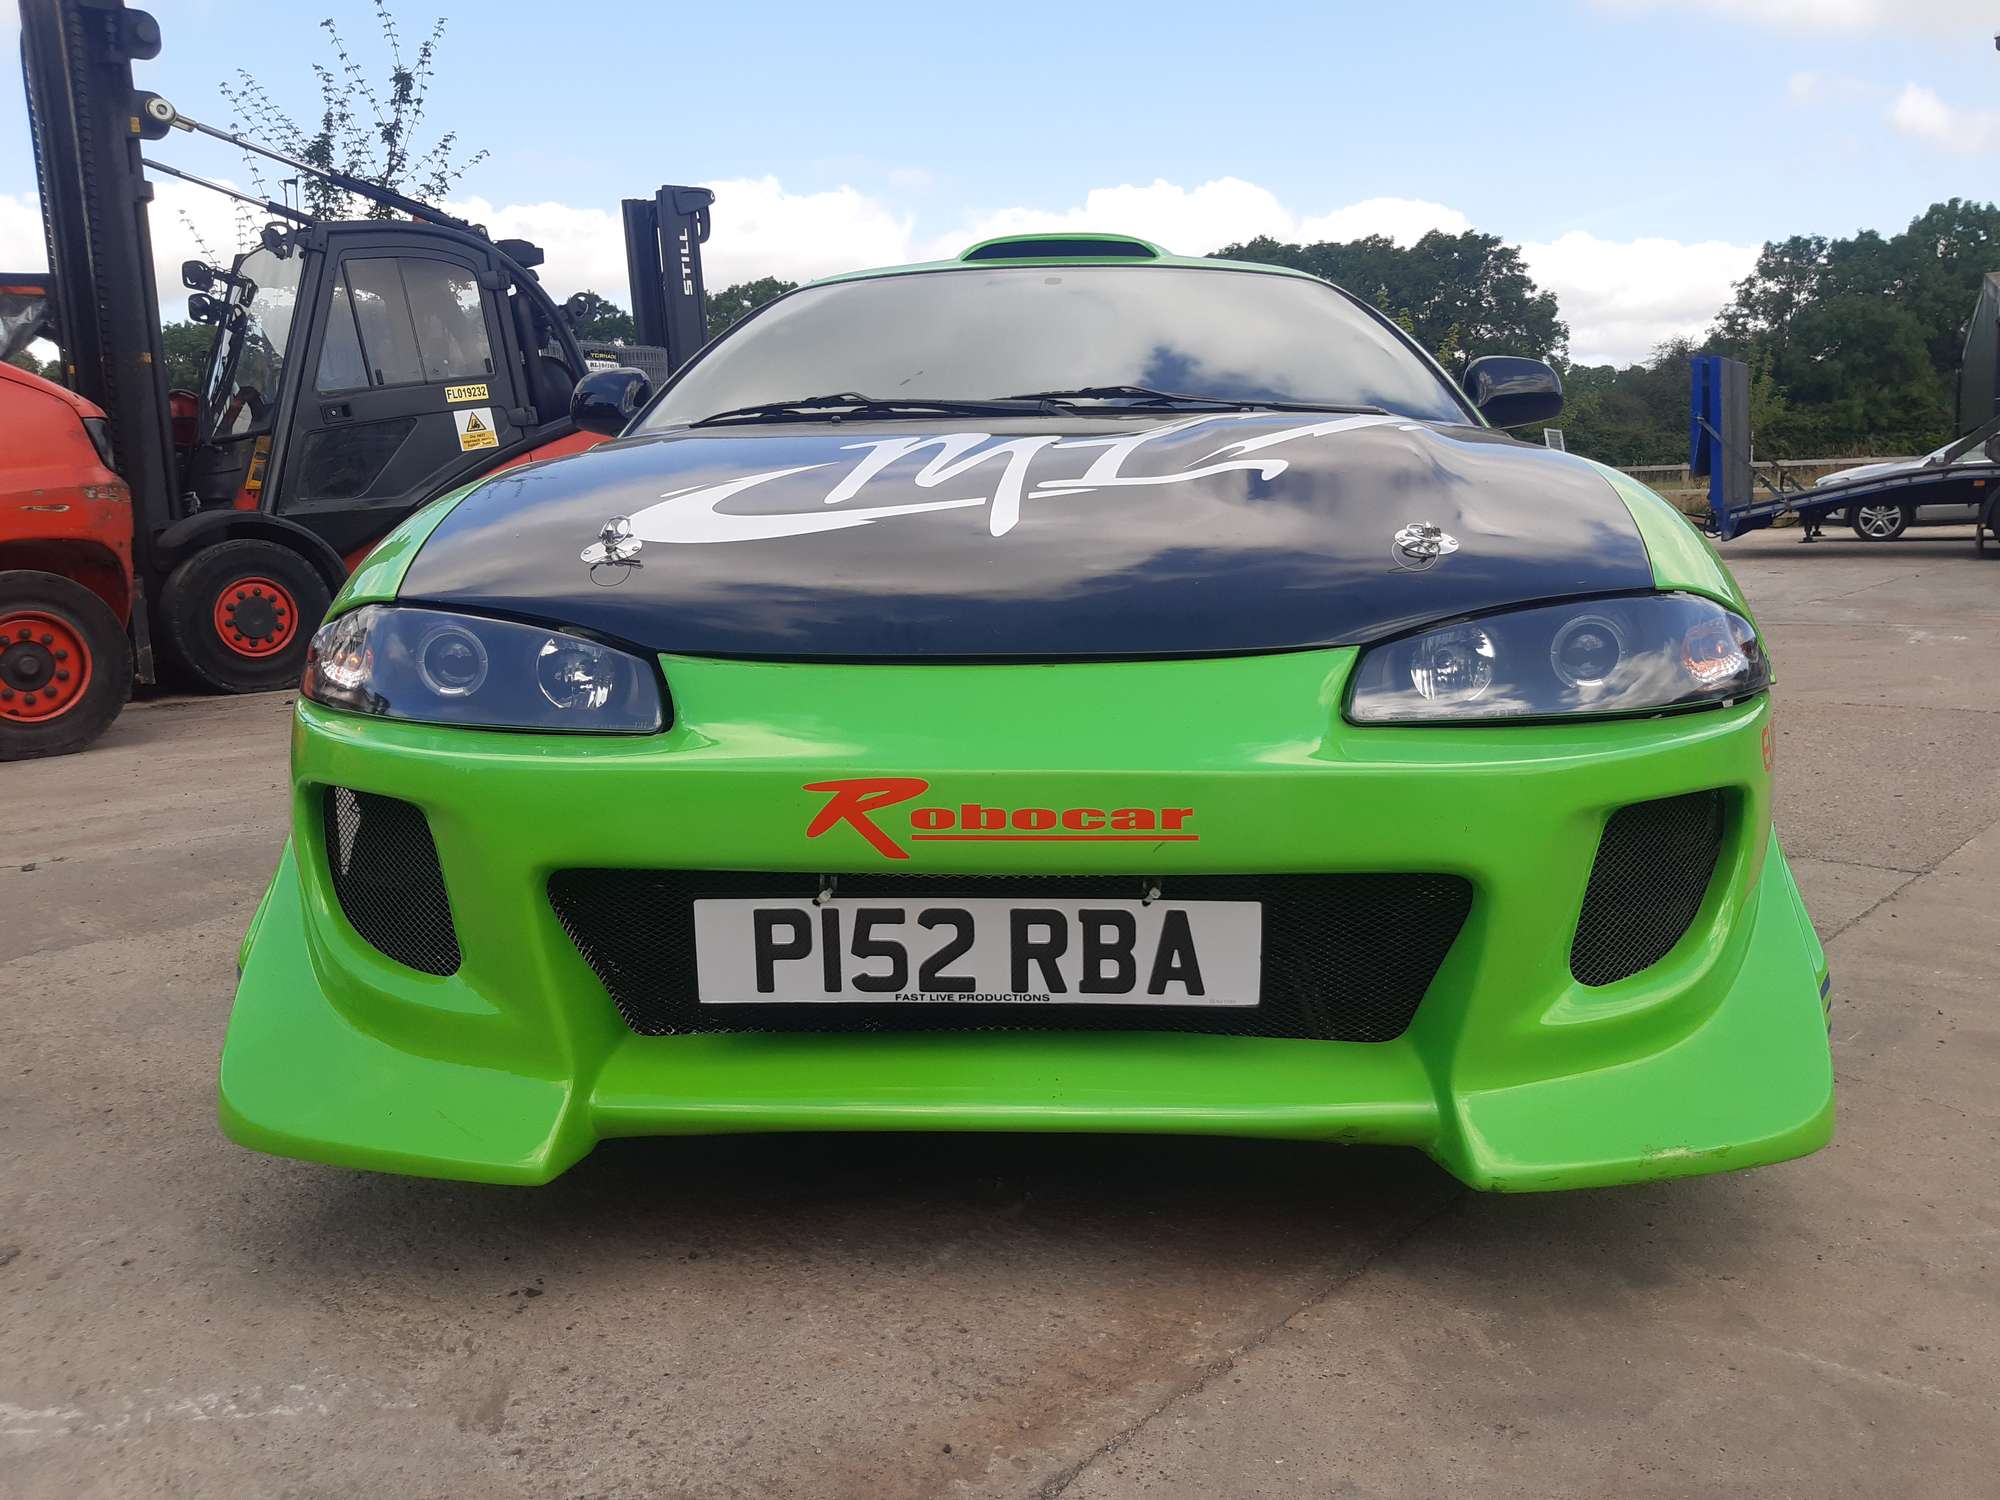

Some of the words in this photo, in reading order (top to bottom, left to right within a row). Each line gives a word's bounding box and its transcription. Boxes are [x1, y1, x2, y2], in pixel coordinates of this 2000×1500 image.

[679, 227, 693, 296] STILL
[446, 385, 487, 400] FL019232
[802, 777, 1197, 860] Robocar
[753, 908, 977, 993] P152
[1010, 908, 1206, 996] RBA
[895, 993, 926, 1001] FAST
[929, 993, 954, 1002] LIVE
[958, 993, 1051, 1002] PRODUCTIONS
